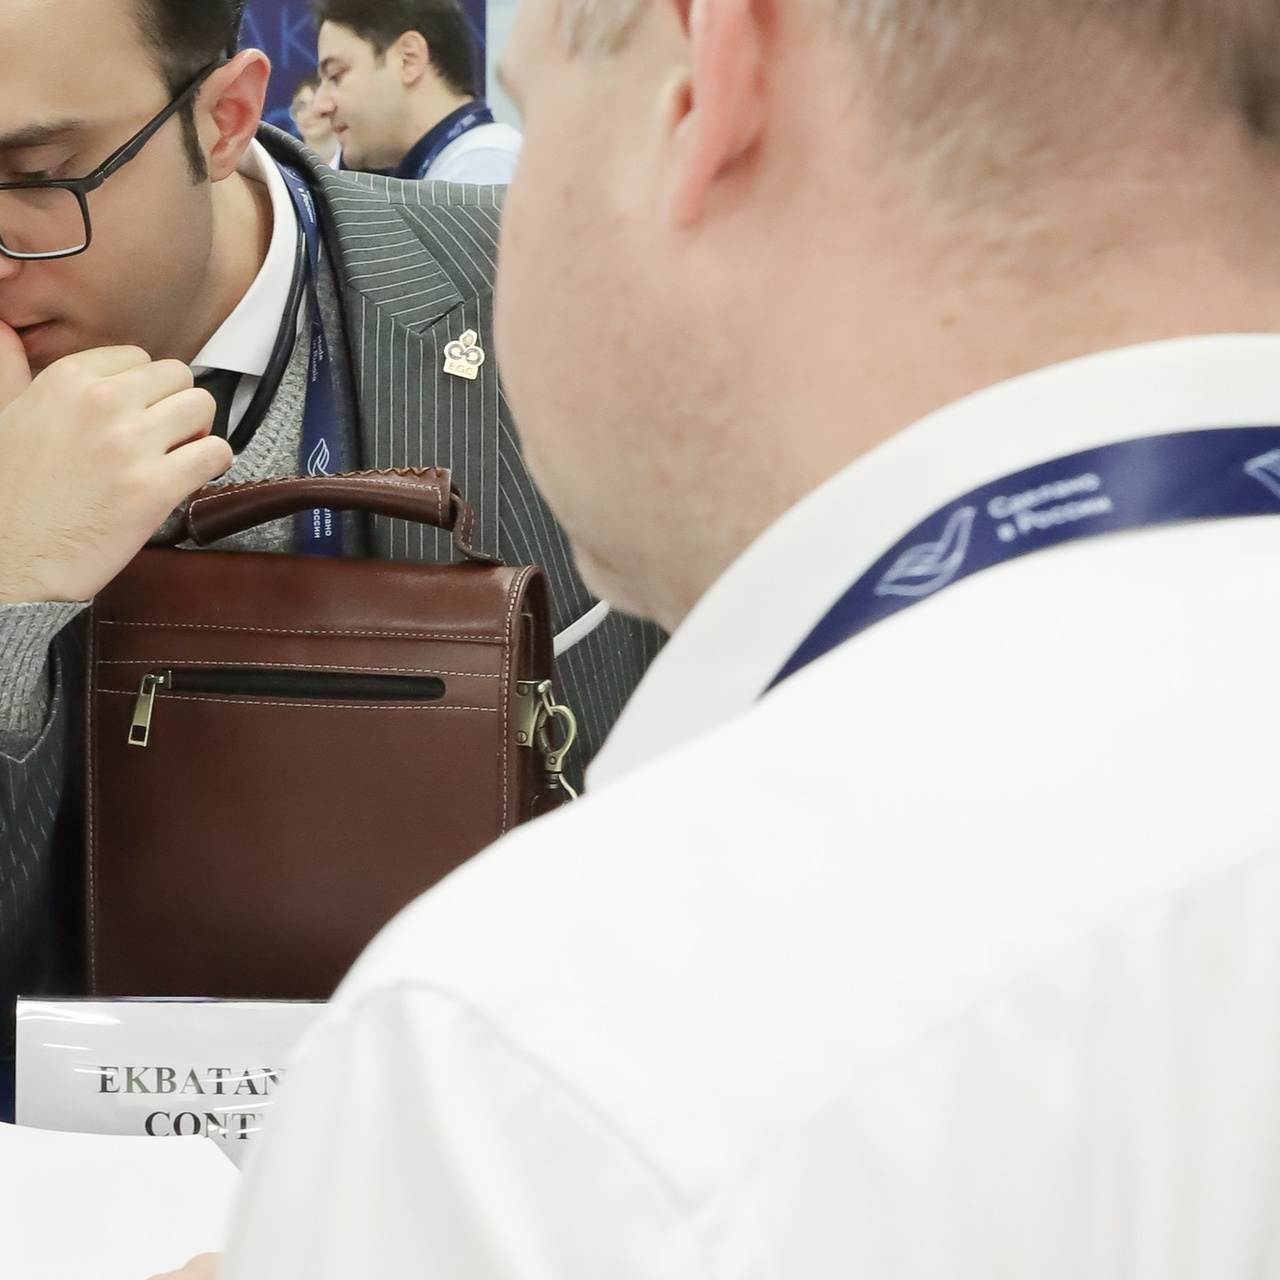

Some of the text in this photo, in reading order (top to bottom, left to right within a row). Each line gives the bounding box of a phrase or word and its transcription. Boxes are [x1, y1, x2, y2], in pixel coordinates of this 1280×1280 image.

[312, 508, 321, 539] оссии
[324, 508, 332, 537] лано
[144, 1110, 257, 1140] CONT
